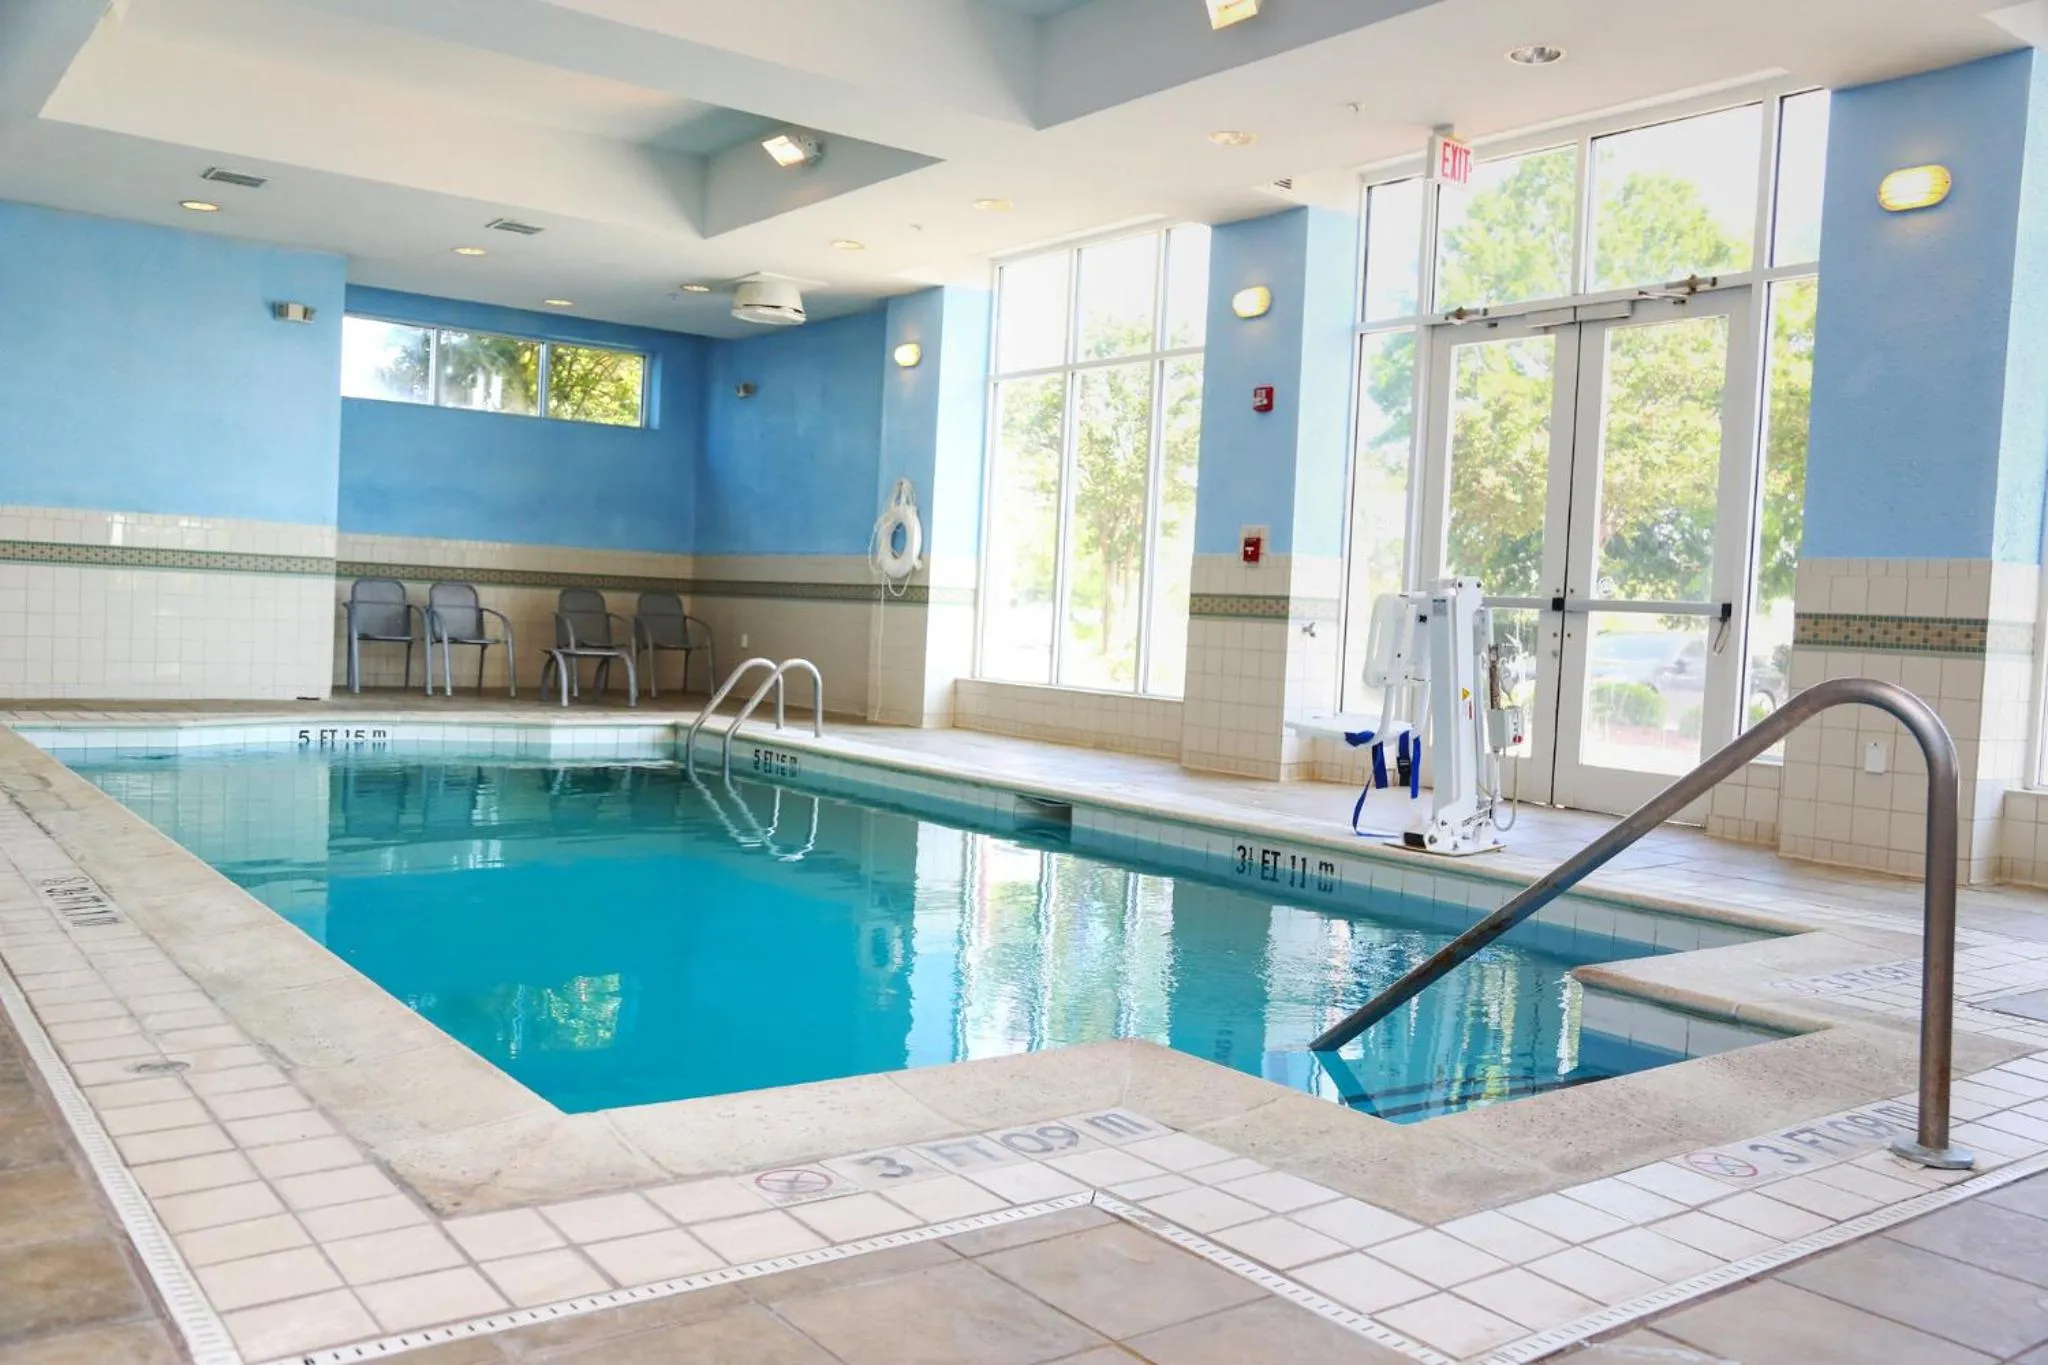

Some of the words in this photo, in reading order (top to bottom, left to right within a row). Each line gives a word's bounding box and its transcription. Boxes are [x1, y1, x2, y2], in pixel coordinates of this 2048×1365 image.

[1441, 142, 1471, 184] EXIT
[298, 729, 311, 745] 5
[1261, 849, 1281, 868] FT
[855, 1155, 914, 1178] 3
[924, 1139, 1003, 1168] FT
[1084, 1113, 1154, 1137] m
[1748, 1144, 1812, 1164] 3
[1780, 1126, 1860, 1156] FT
